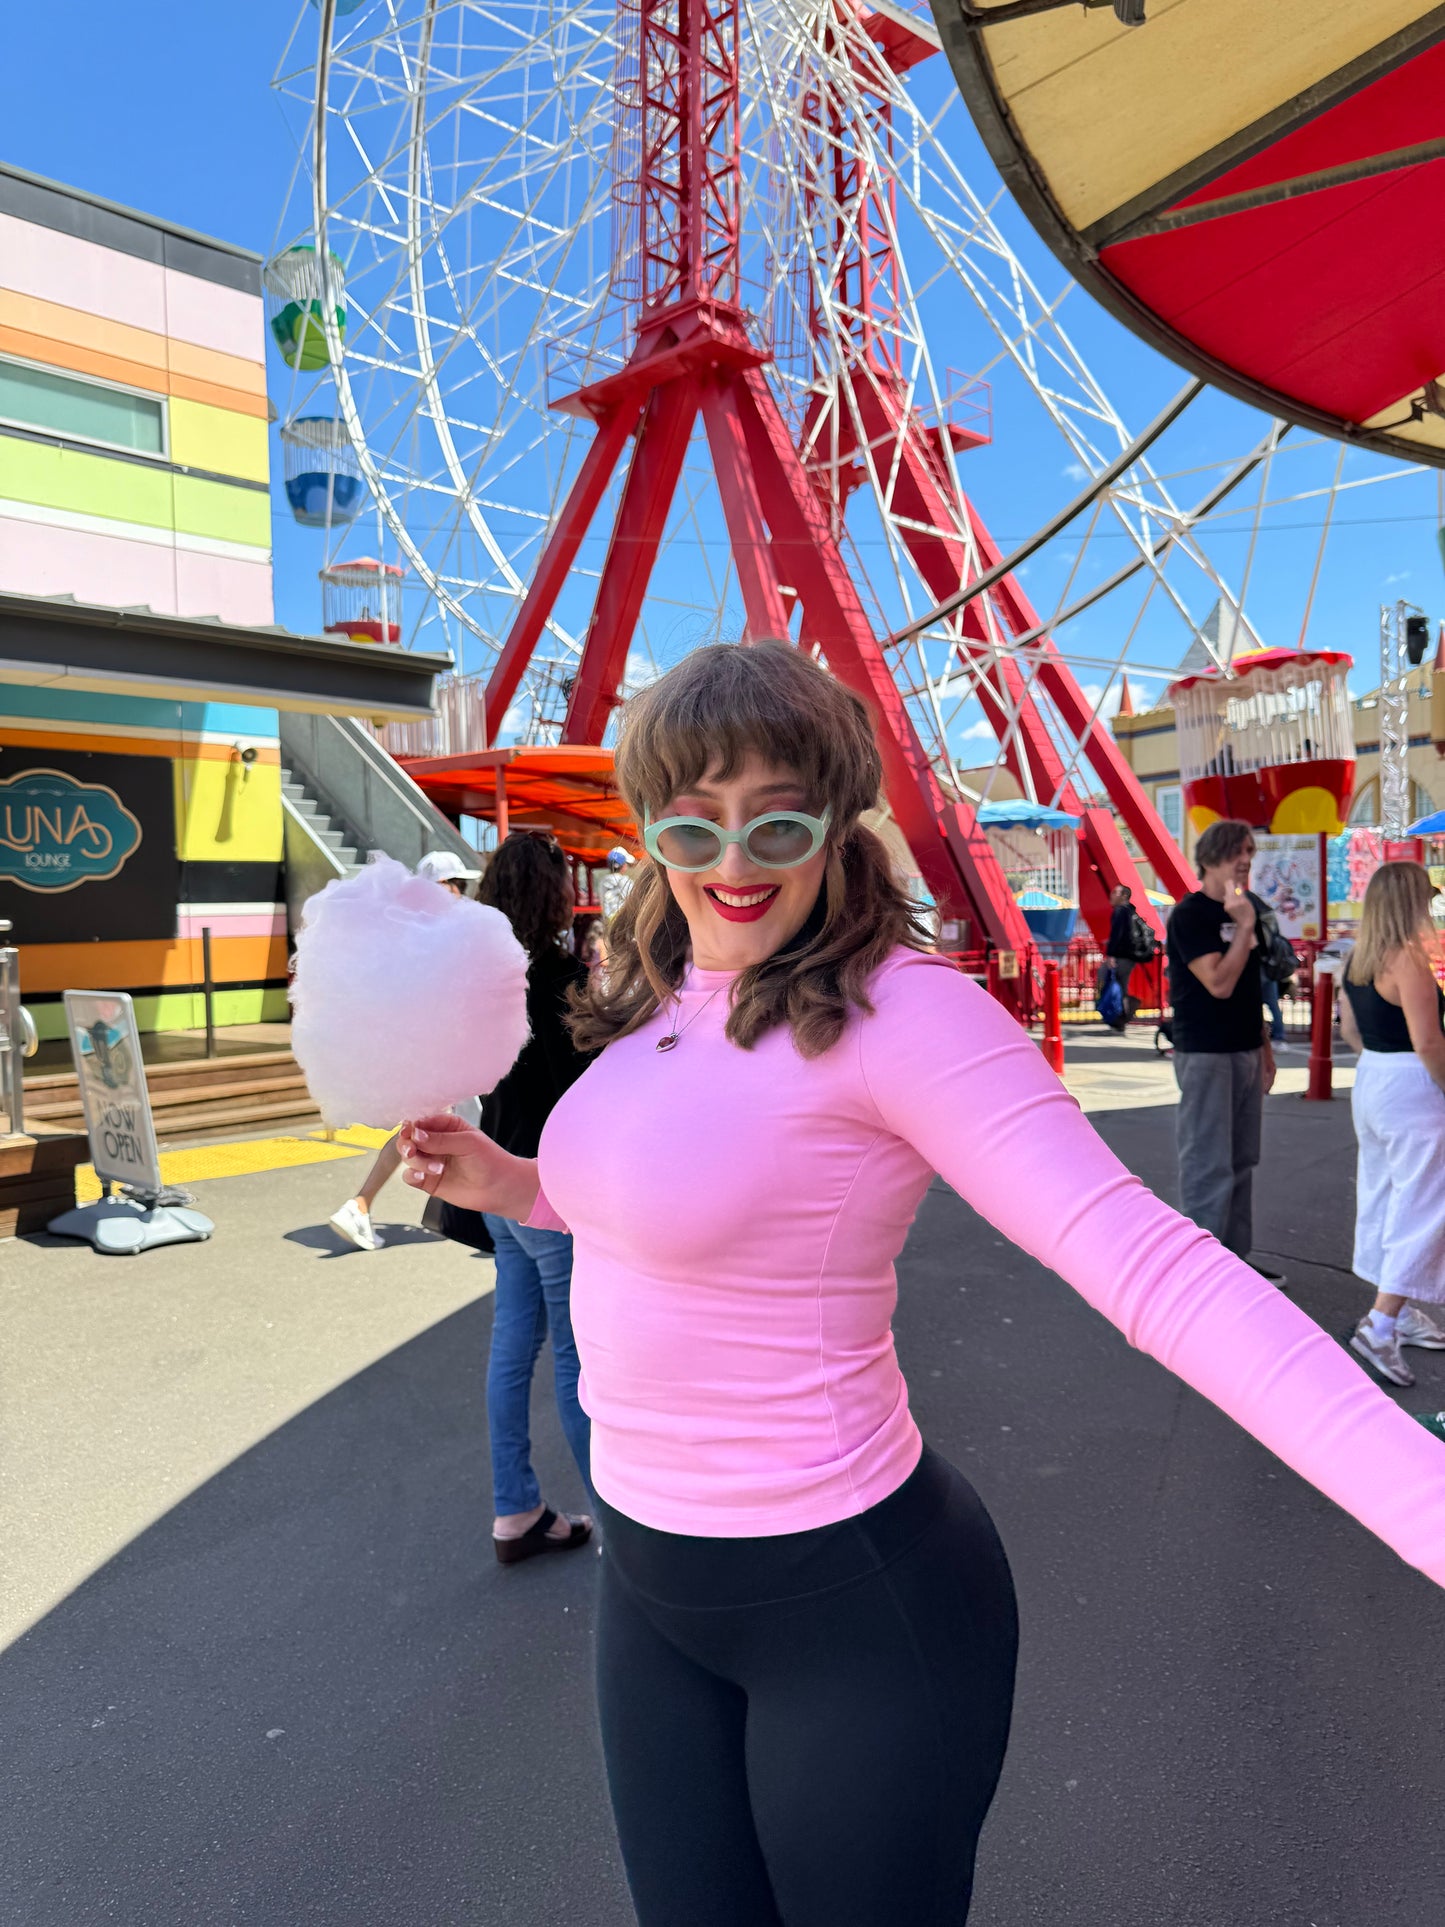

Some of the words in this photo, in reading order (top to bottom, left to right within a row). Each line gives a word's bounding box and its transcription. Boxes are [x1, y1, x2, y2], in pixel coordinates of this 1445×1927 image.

[25, 853, 71, 867] LOUNGE
[97, 1101, 135, 1131] NOW
[104, 1131, 145, 1166] OPEN
